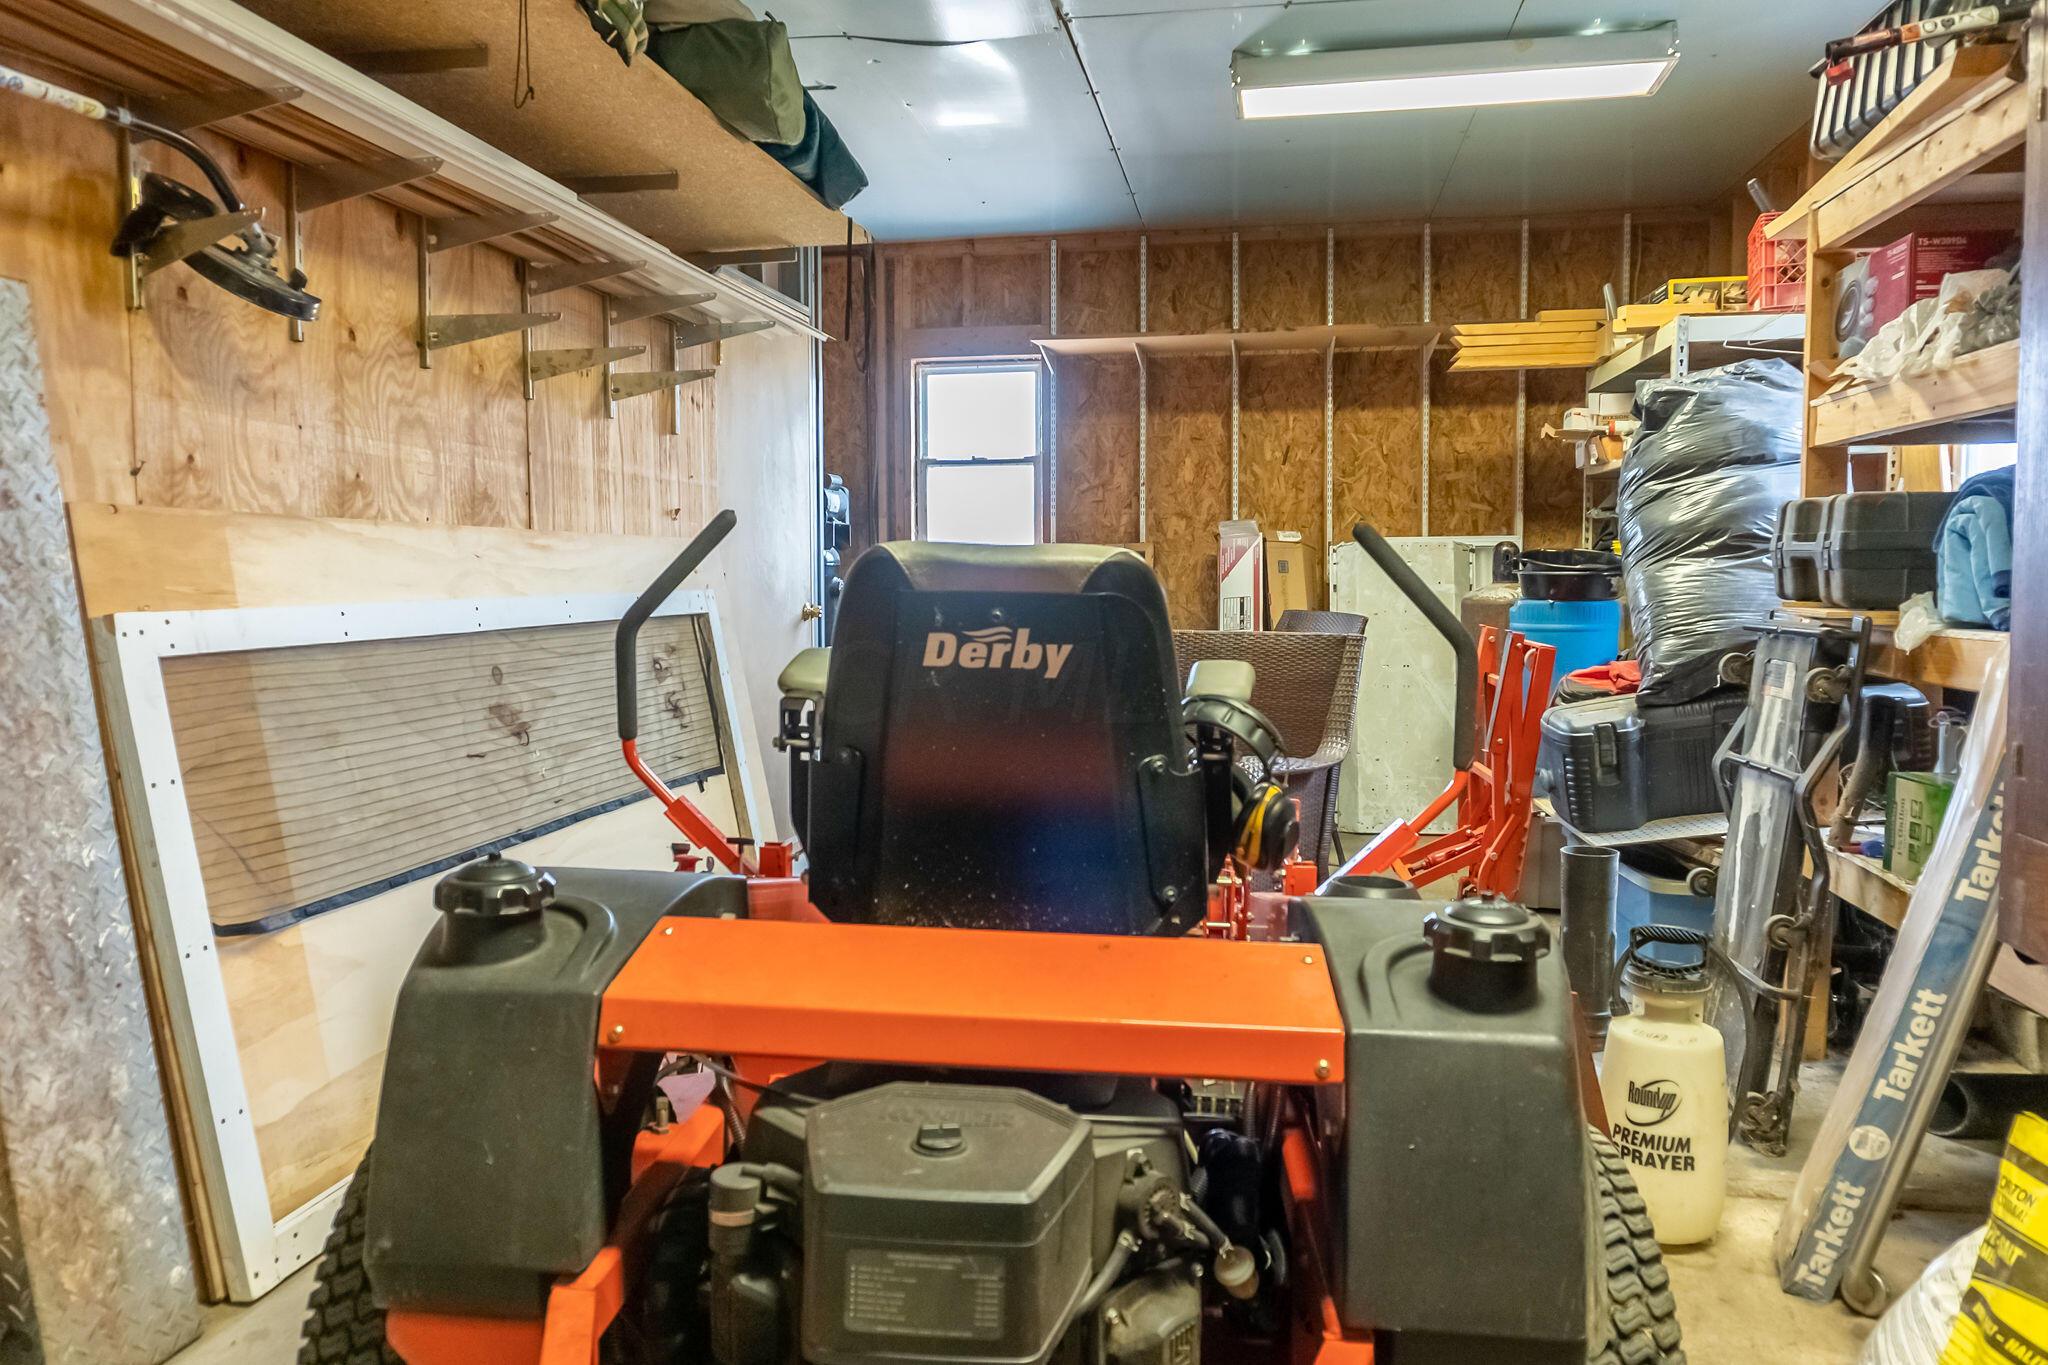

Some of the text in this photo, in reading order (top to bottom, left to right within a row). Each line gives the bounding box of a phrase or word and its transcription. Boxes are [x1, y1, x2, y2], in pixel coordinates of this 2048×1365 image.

[922, 627, 1075, 679] Derby
[1873, 988, 1948, 1102] Tarkett
[1613, 1123, 1691, 1153] PREMIUM
[1999, 1175, 2037, 1208] ORTON
[1794, 1181, 1866, 1286] Tarkett
